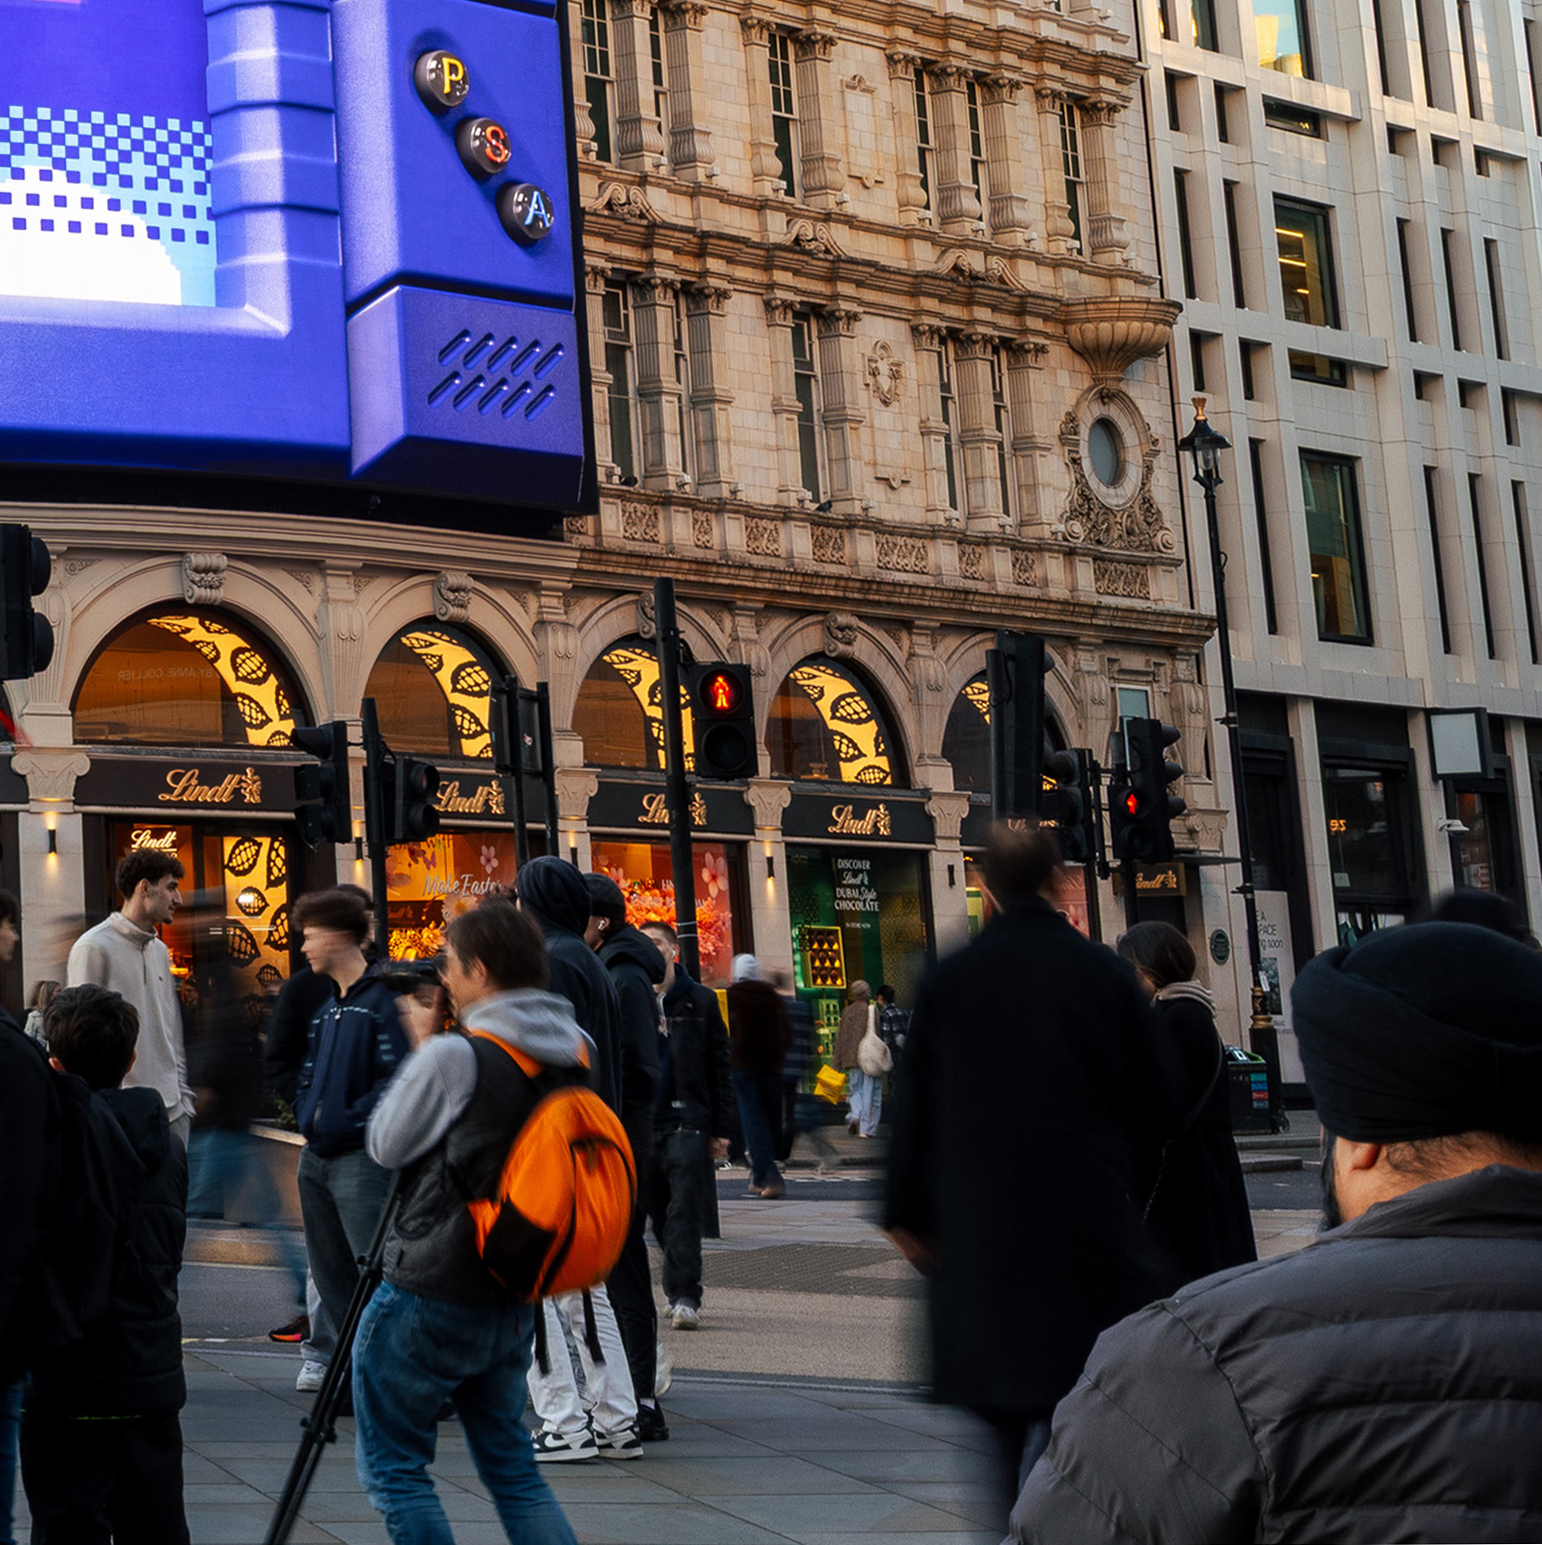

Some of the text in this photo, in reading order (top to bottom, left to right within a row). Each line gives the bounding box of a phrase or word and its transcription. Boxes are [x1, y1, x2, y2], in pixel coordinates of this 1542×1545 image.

[442, 57, 464, 94] P
[485, 126, 507, 162] S
[524, 191, 551, 228] A
[158, 769, 241, 803] Lindt
[433, 781, 489, 813] Lindt
[828, 805, 878, 835] Lindt
[131, 830, 177, 848] Lindt
[837, 859, 871, 870] DISCOVER
[422, 874, 460, 897] Make
[836, 887, 859, 898] DUBAI
[834, 900, 879, 912] CHOCOLATE
[1259, 924, 1277, 936] PACE
